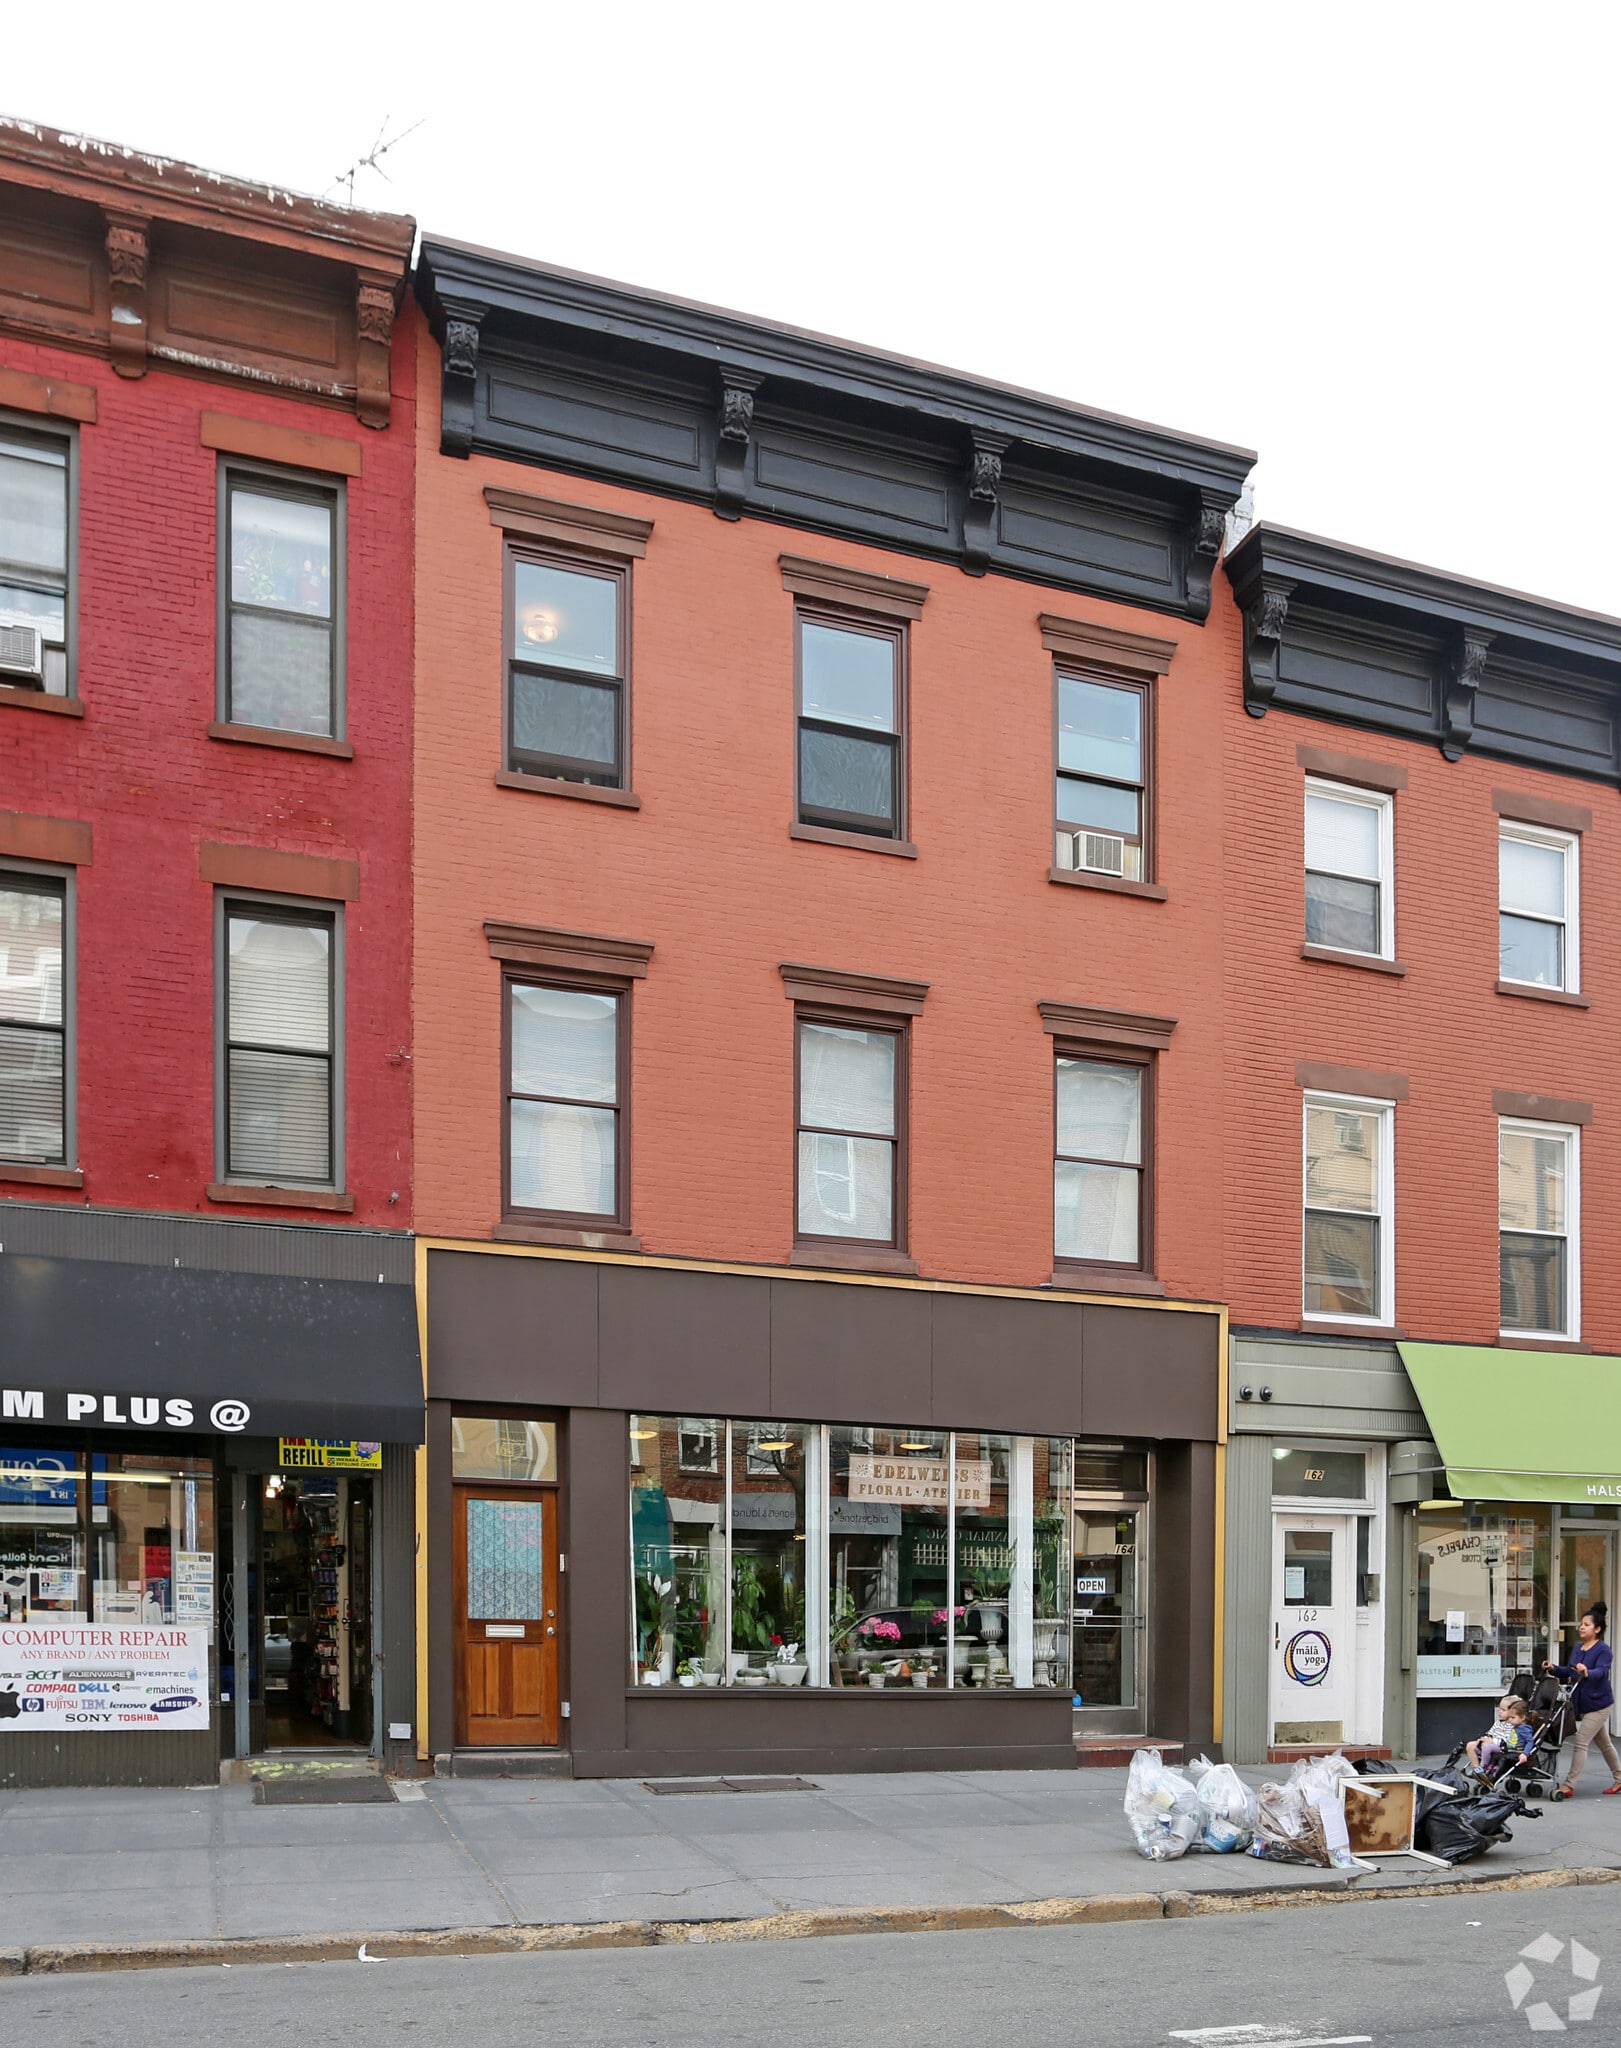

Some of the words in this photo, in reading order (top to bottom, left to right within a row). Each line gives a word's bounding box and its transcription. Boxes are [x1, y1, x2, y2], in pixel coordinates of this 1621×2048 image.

[67, 1393, 194, 1427] PLUS
[209, 1399, 250, 1432] @
[283, 1448, 324, 1465] REFILL
[873, 1464, 969, 1483] EDELWEIS
[1306, 1470, 1323, 1480] 162
[859, 1484, 912, 1497] FLORAL
[922, 1487, 980, 1500] ATEIER
[1116, 1545, 1134, 1554] 164
[1079, 1580, 1104, 1591] OPEN
[1298, 1609, 1317, 1622] 162
[2, 1629, 113, 1646] COMPUTER
[119, 1630, 188, 1647] REPAIR
[20, 1650, 44, 1659] ANY
[47, 1650, 86, 1659] BRAND
[94, 1650, 117, 1659] ANY
[120, 1650, 170, 1660] PROBLEM
[1304, 1656, 1326, 1667] yoga
[26, 1669, 61, 1680] acer
[1462, 1667, 1498, 1676] PROPERTY
[26, 1683, 77, 1693] COMPAQ
[78, 1683, 109, 1692] DELL
[145, 1685, 194, 1694] emachines
[25, 1698, 41, 1711] hp
[46, 1697, 78, 1711] FUJITSU
[81, 1699, 105, 1710] IBM
[109, 1701, 147, 1709] lenovo
[65, 1713, 113, 1723] SONY
[117, 1713, 159, 1722] TOSHIBA
